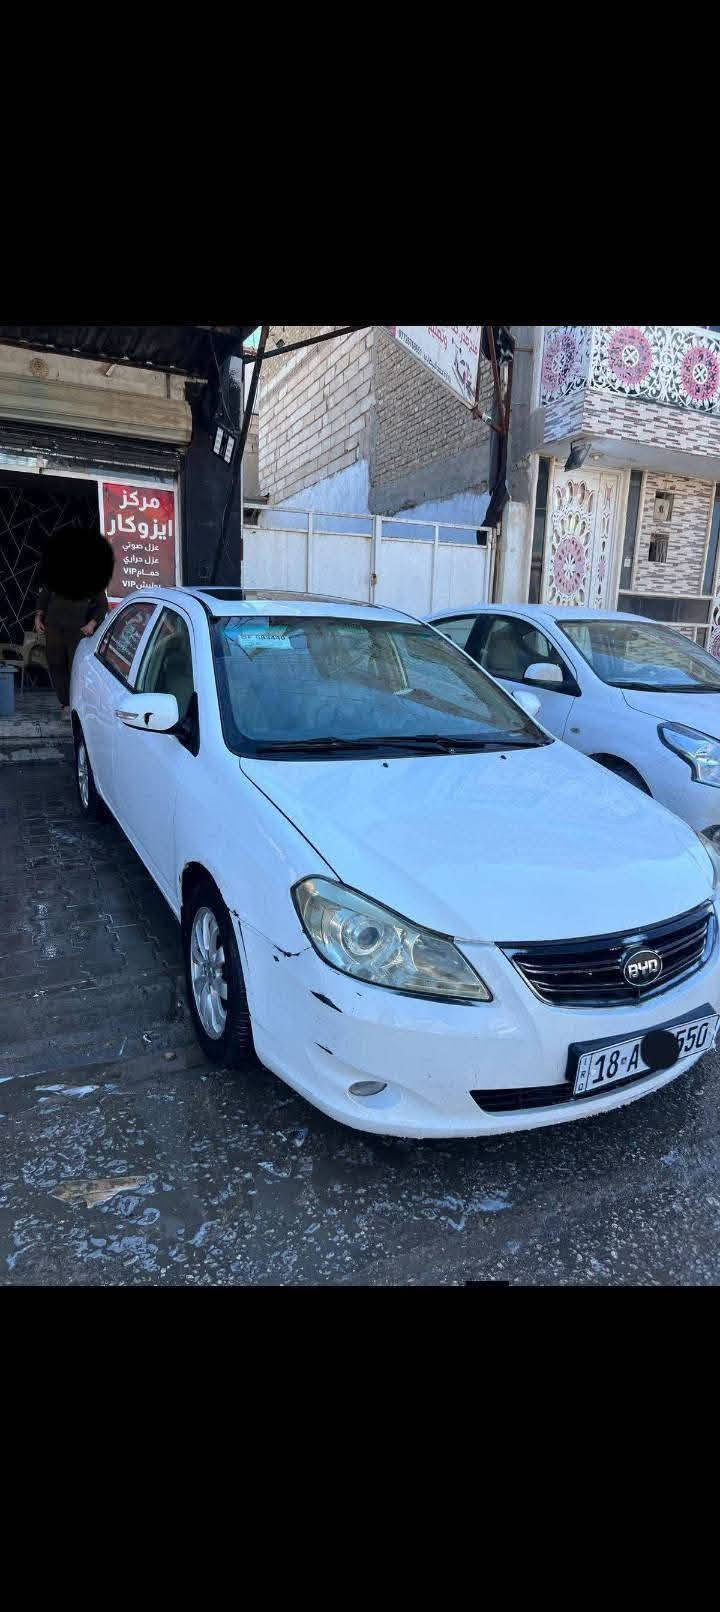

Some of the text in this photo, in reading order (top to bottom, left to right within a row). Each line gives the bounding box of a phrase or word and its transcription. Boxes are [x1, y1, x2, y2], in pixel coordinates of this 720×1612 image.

[119, 490, 160, 511] مركز
[106, 514, 173, 540] ايزوكار
[121, 541, 160, 552] عزل صوتي
[123, 554, 160, 565] عزل حراري
[627, 958, 658, 978] BYD
[592, 1050, 620, 1084] 18
[627, 1043, 640, 1073] A
